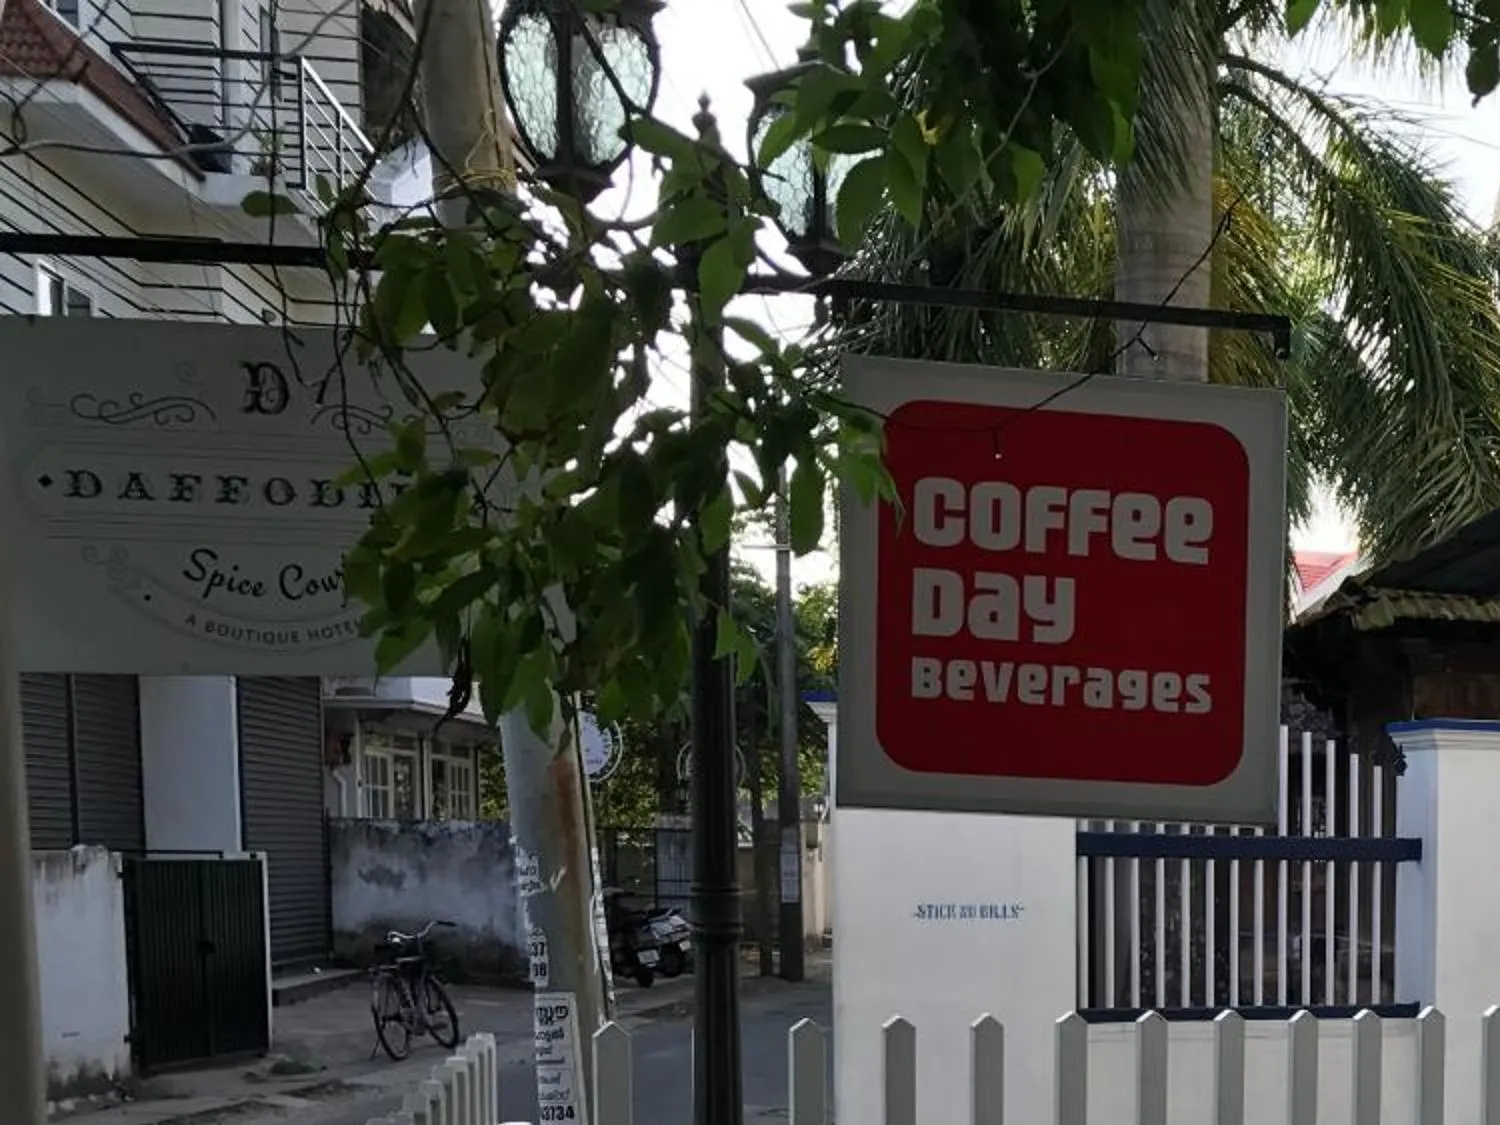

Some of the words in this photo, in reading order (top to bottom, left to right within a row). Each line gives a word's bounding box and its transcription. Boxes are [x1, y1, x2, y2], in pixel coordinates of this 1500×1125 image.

[181, 547, 267, 600] Spice
[184, 613, 197, 627] A
[204, 619, 300, 646] BOUTIQUE
